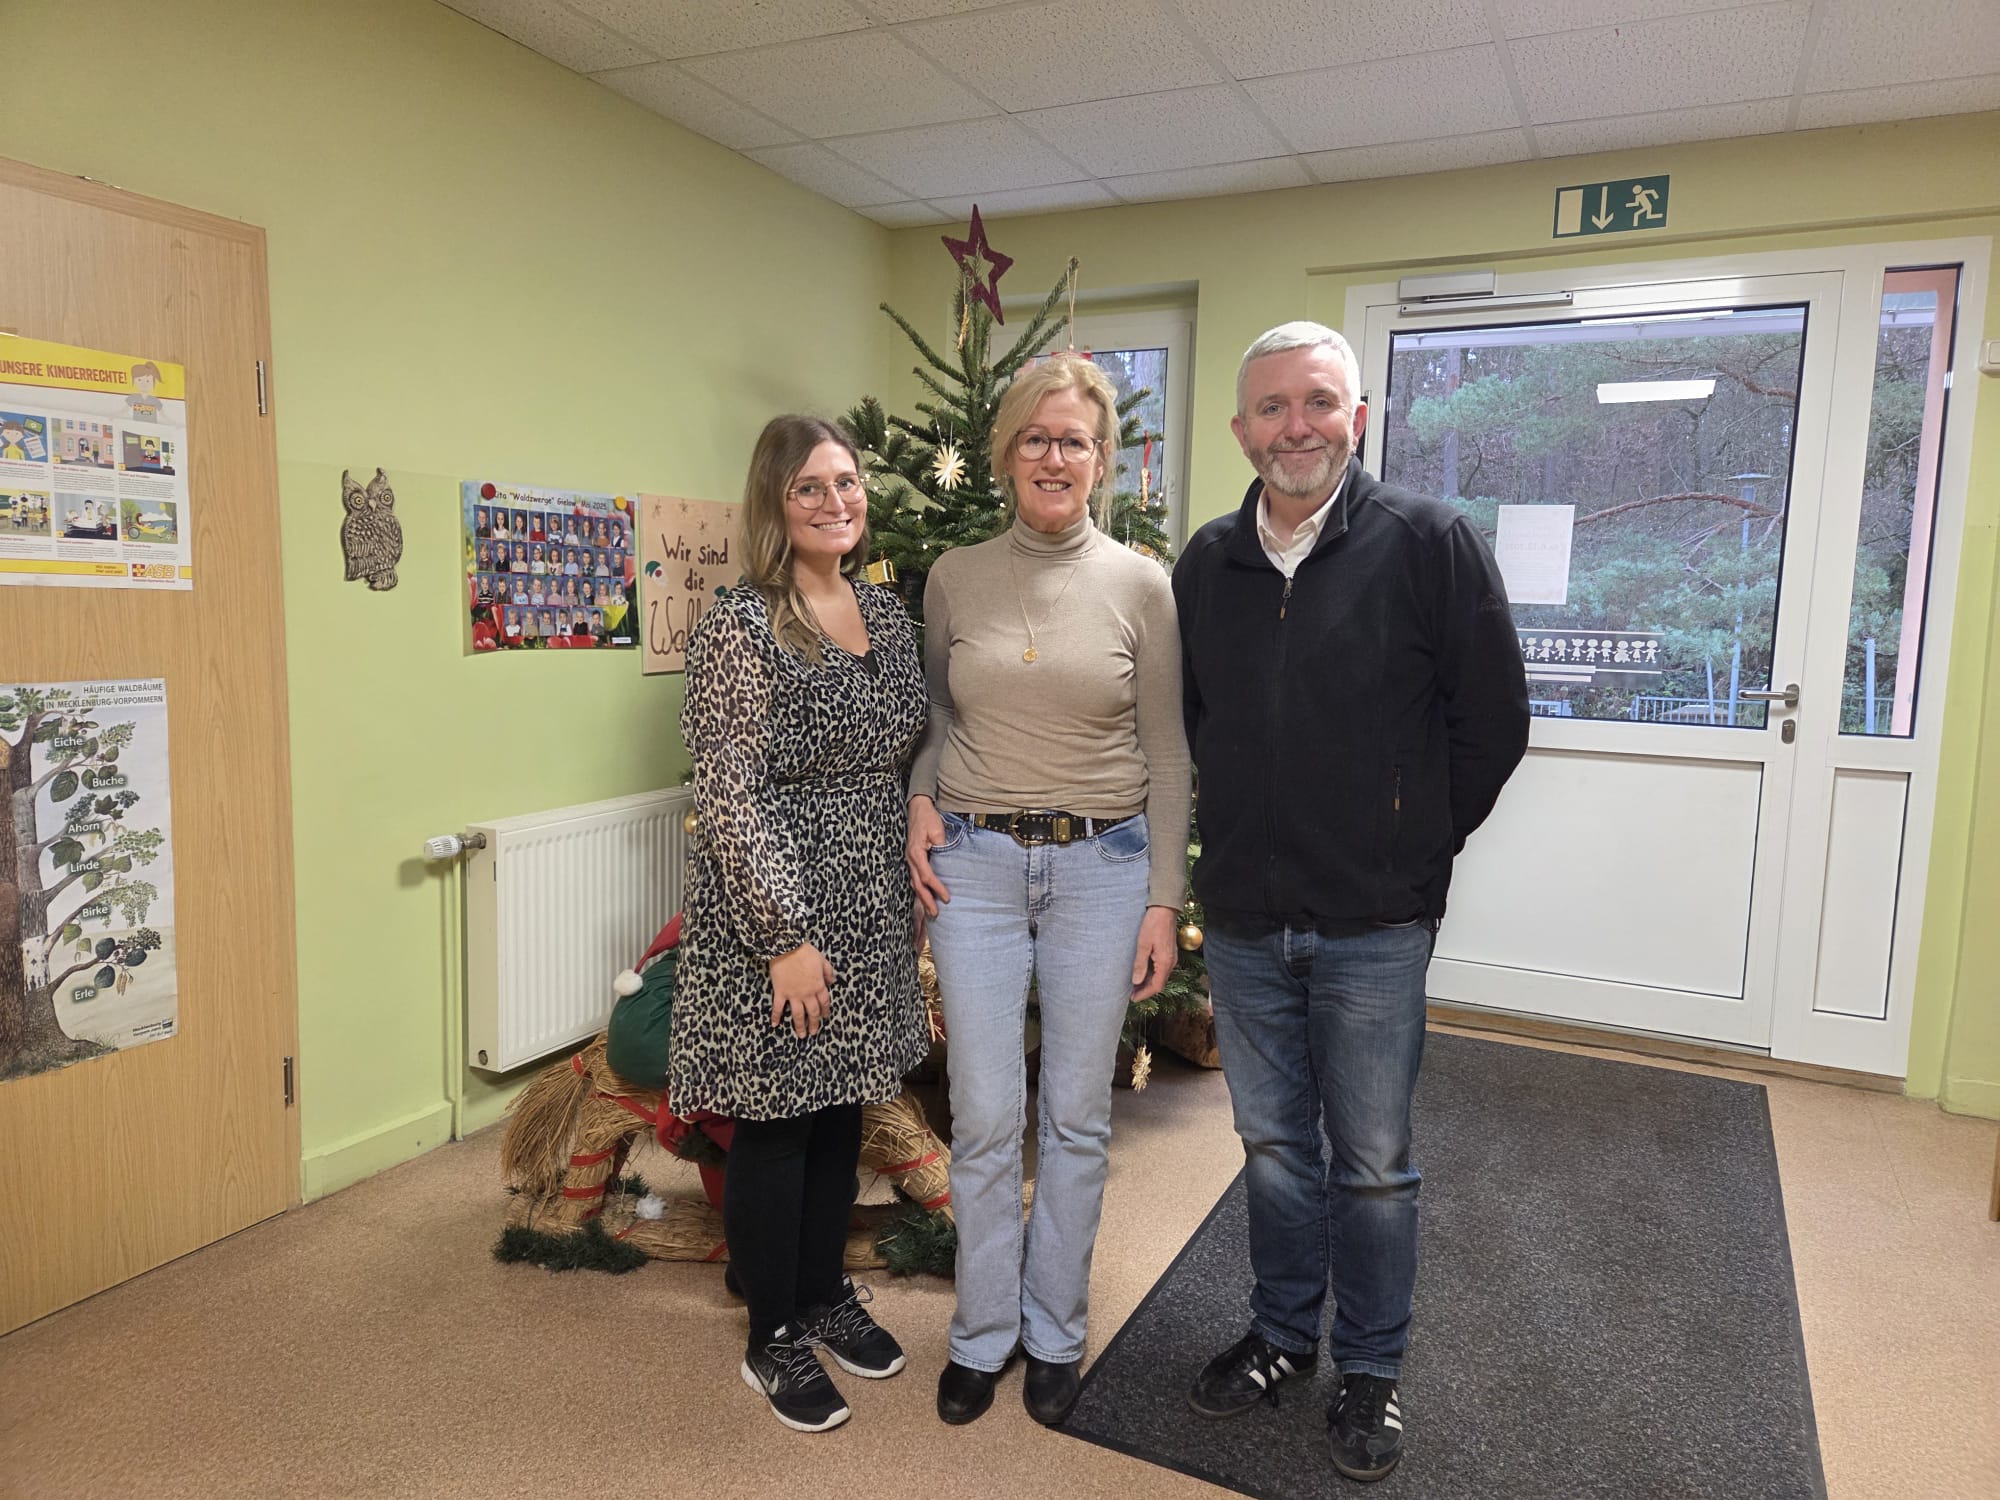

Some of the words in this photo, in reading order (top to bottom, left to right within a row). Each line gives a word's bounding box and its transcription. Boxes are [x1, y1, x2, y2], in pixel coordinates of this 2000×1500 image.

[0, 360, 43, 377] UNSERE
[46, 364, 127, 384] KINDERRECHTE!
[495, 490, 507, 500] ita
[662, 533, 691, 562] Wir
[698, 537, 728, 565] sind
[144, 564, 176, 579] ASB
[684, 568, 704, 591] die
[83, 685, 116, 694] HÄUFIGE
[117, 683, 163, 693] WALDBÄUME
[46, 701, 55, 710] IN
[57, 695, 163, 709] MECKLENBURG-VORPOMMERN
[54, 736, 84, 747] Eiche
[92, 776, 124, 787] Buche
[68, 823, 100, 834] Ahorn
[70, 860, 100, 873] Linde
[82, 906, 109, 917] Birke
[74, 989, 95, 1000] Erle
